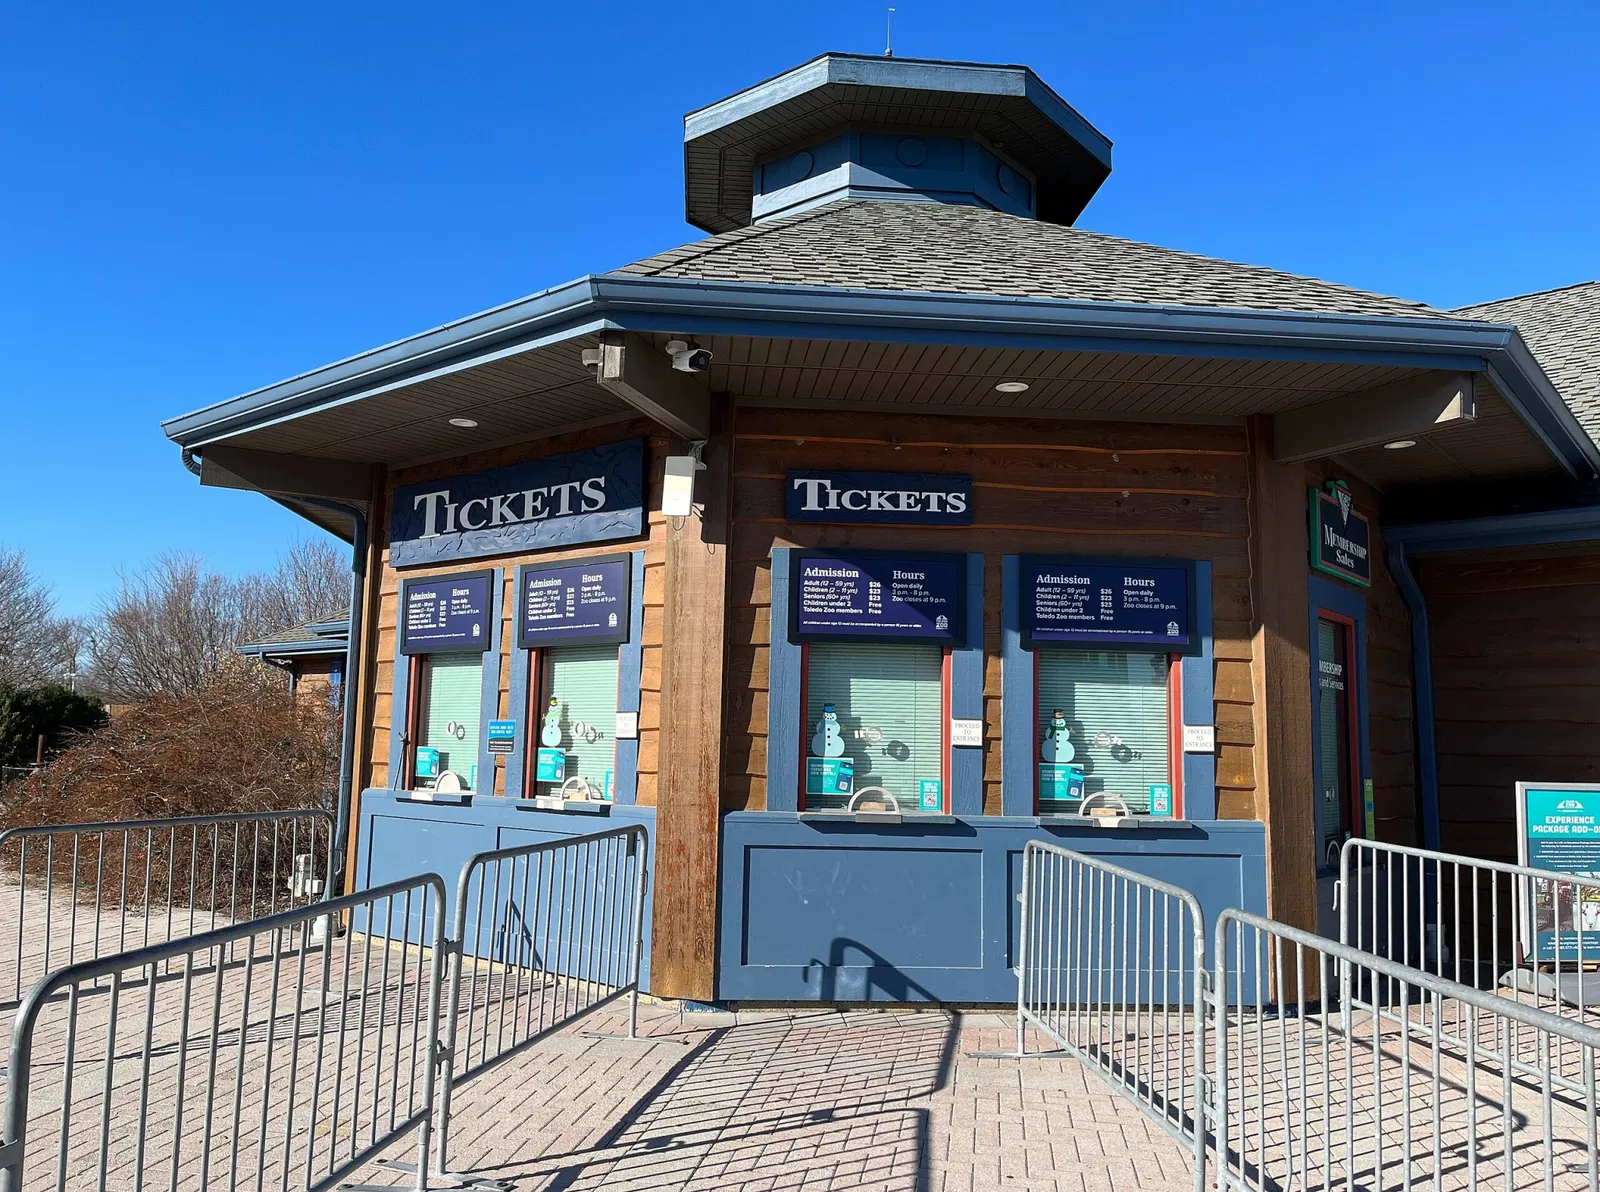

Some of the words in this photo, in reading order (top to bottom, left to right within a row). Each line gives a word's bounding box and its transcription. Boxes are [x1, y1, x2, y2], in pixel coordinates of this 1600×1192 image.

[794, 478, 966, 513] TICKETS
[414, 476, 605, 539] TICKETS
[1324, 524, 1366, 559] MEMBERSHIP
[1337, 550, 1354, 568] Sales
[804, 568, 859, 577] Admission
[893, 571, 924, 580] Hours
[529, 578, 561, 588] Admission
[1036, 575, 1090, 584] Admission
[1124, 577, 1155, 586] Hours
[1330, 678, 1343, 690] Services
